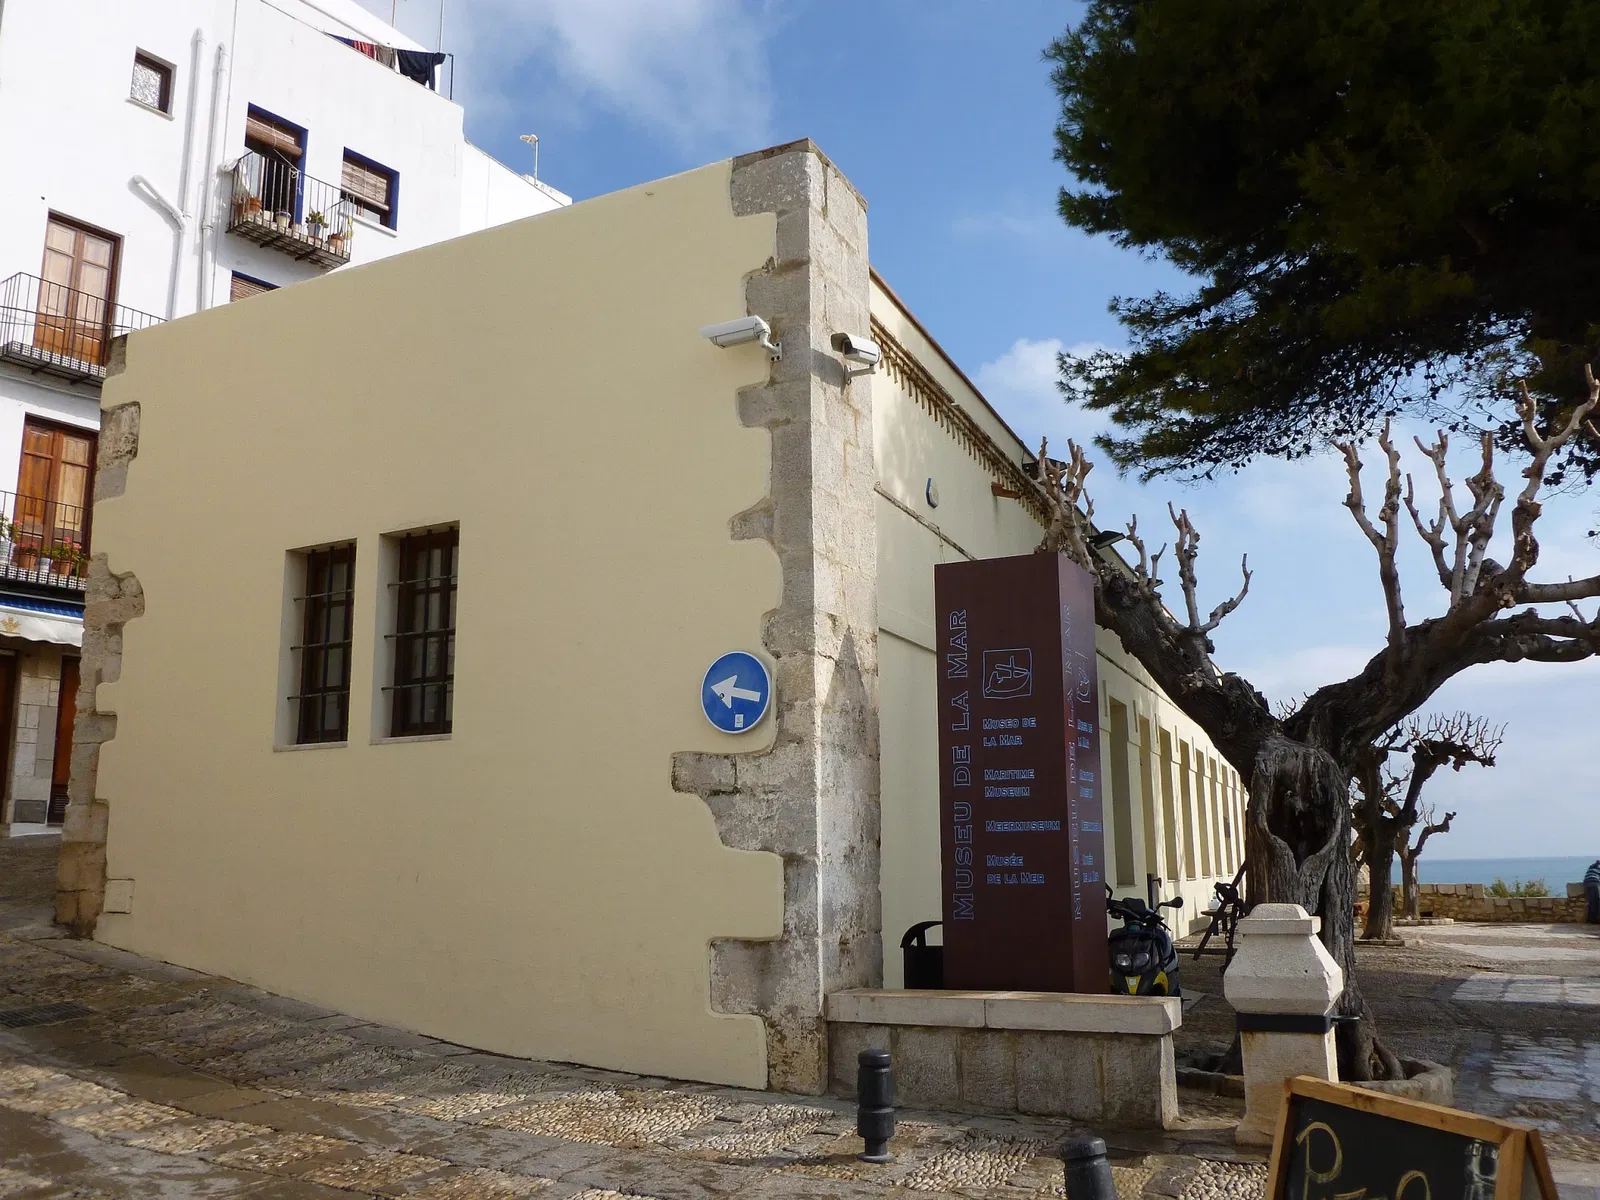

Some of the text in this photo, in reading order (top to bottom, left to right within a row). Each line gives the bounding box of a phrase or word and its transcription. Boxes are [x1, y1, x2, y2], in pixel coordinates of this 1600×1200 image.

[982, 717, 1037, 730] MUSEO DE
[983, 734, 1023, 747] LA MAR
[948, 609, 974, 920] MUSEU DE LA MAR
[984, 769, 1035, 780] MARITIME
[984, 786, 1030, 798] MUSEUM
[986, 820, 1060, 832] MEERMUSEUM
